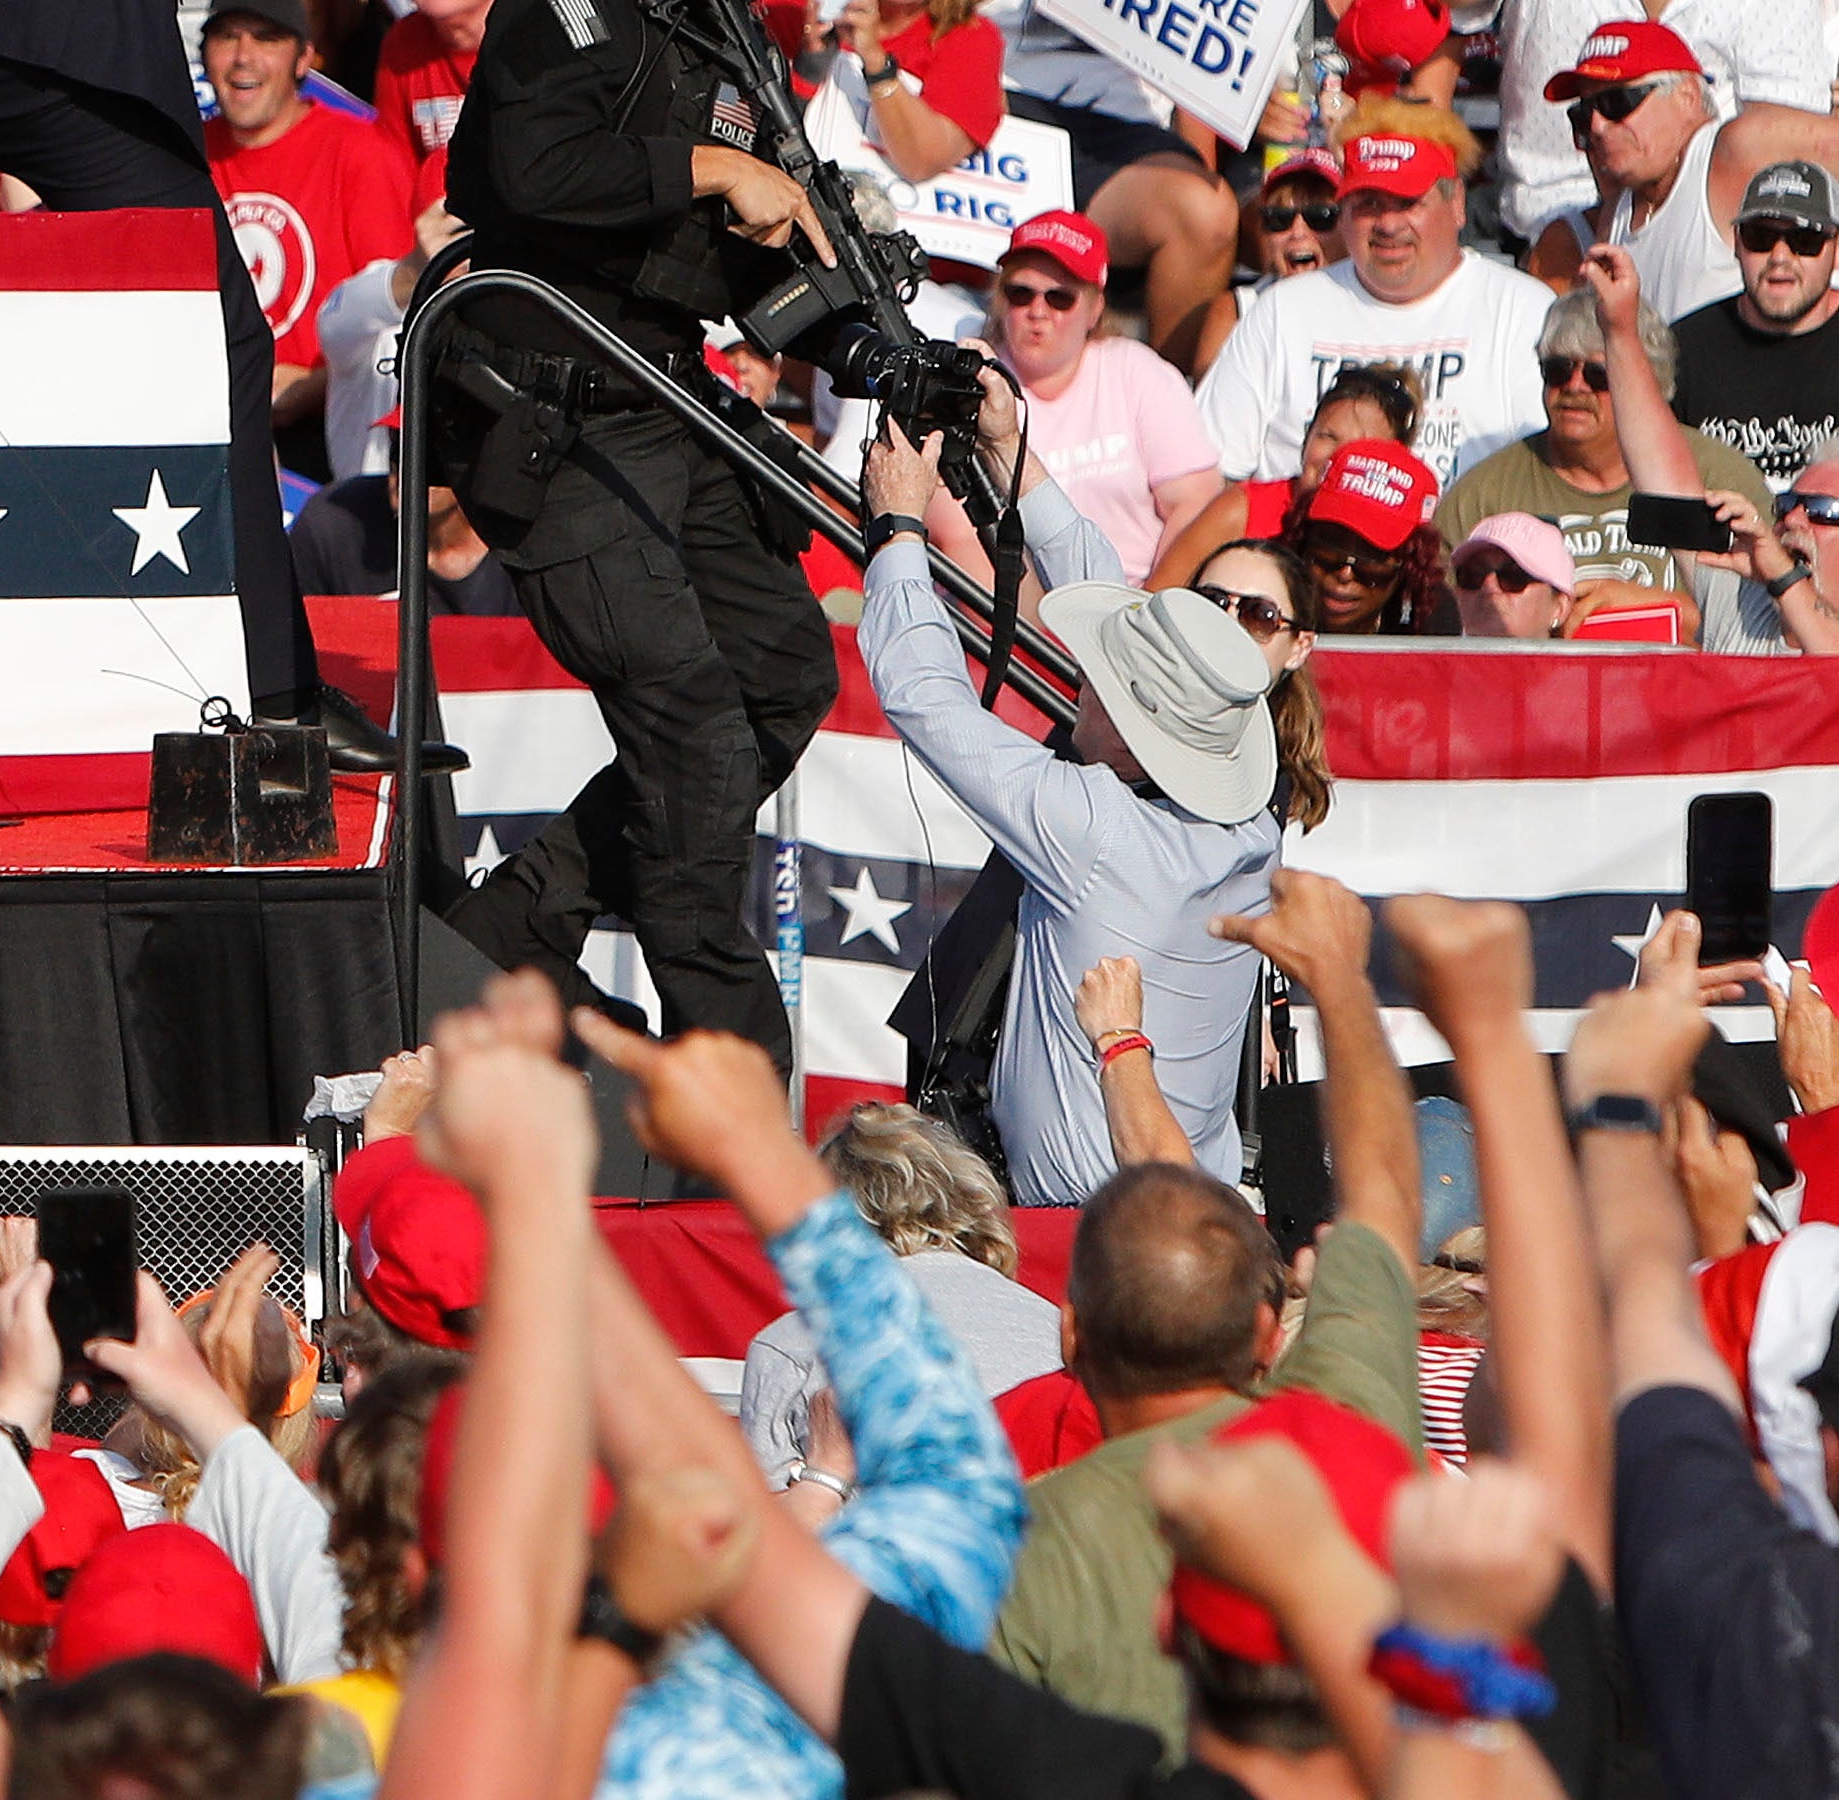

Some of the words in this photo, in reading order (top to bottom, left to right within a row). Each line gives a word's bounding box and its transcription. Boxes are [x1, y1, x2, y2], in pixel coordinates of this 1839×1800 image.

[1581, 34, 1631, 59] UMP
[710, 116, 757, 150] POLICE
[1358, 136, 1417, 163] Trump
[933, 187, 1016, 228] RIG
[1699, 416, 1739, 447] We
[1738, 414, 1778, 458] The
[1341, 472, 1405, 508] TRUMP
[1346, 454, 1415, 490] MARYLAND
